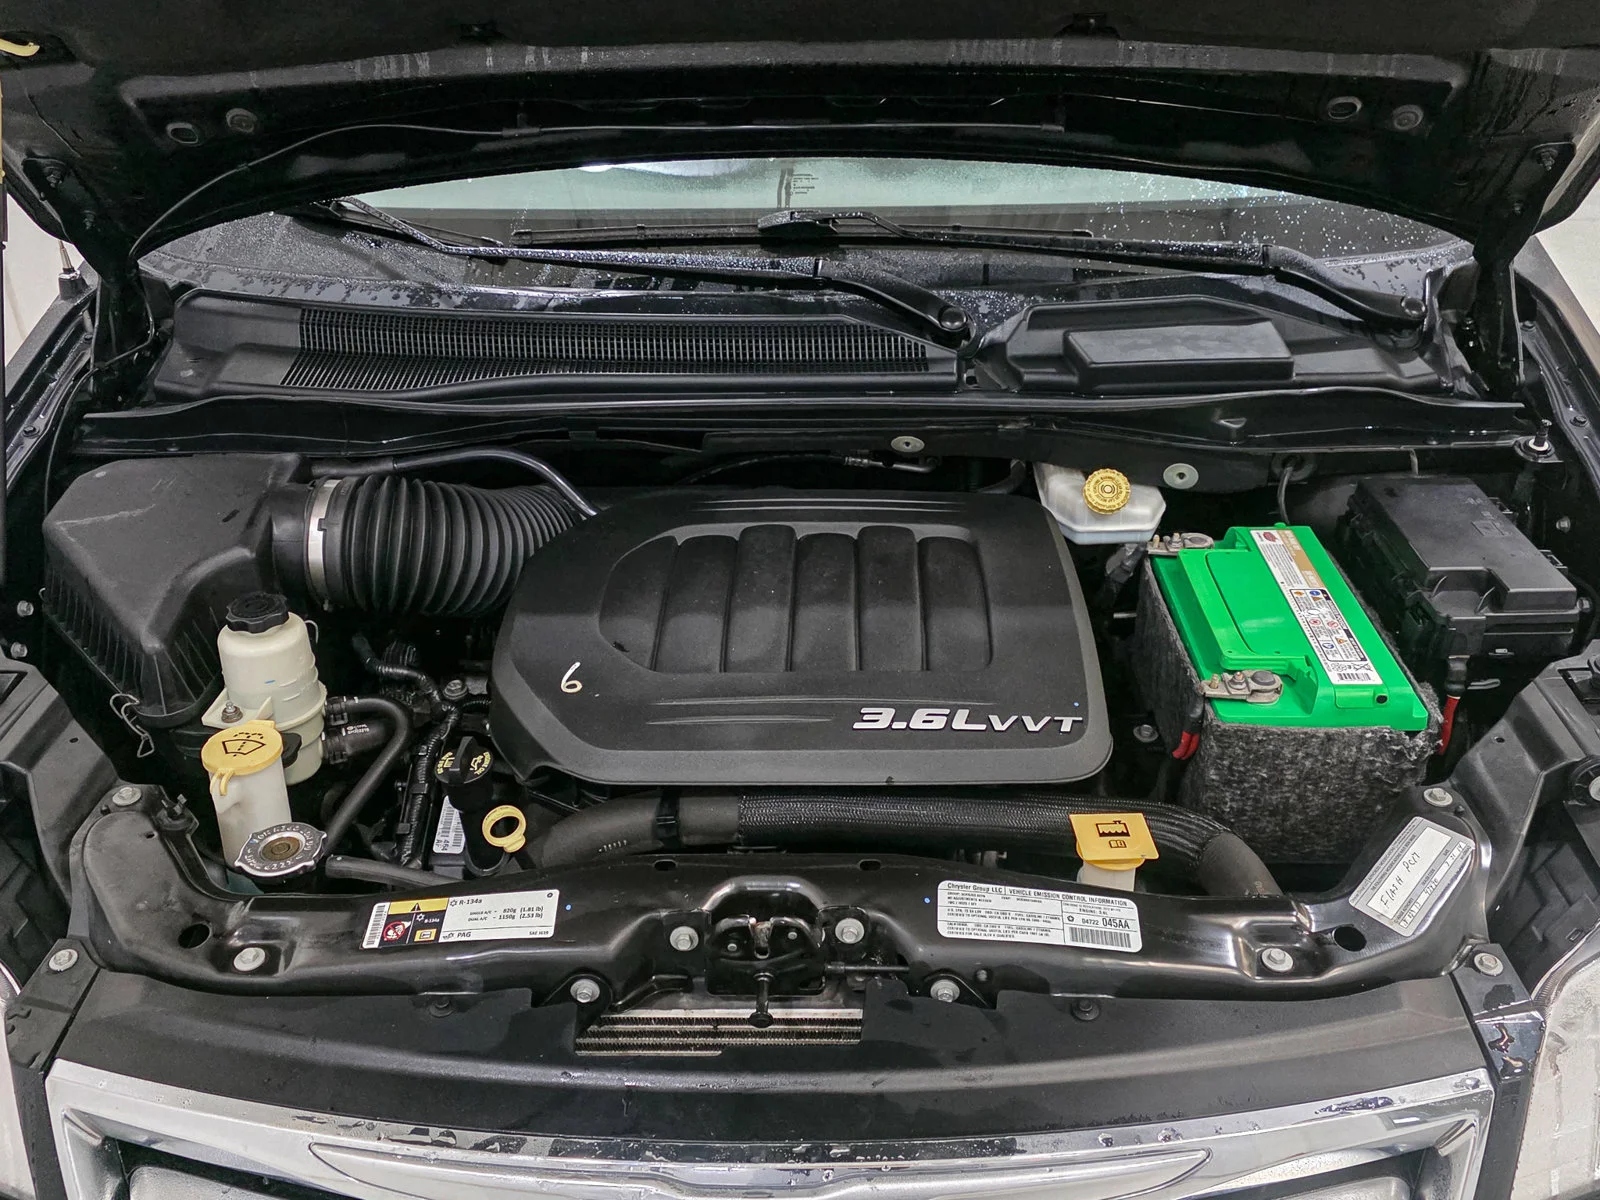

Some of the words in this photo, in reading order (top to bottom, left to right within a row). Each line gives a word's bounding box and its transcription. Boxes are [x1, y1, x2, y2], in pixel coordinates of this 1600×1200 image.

[560, 661, 583, 693] 6
[852, 707, 987, 731] 3.6L
[987, 714, 1084, 732] VVT
[947, 882, 971, 891] Chrysler
[972, 884, 990, 893] Group
[459, 898, 482, 906] R-134a
[1008, 888, 1031, 896] VEHICLE
[1033, 890, 1060, 899] EMISSION
[1062, 894, 1087, 902] CONTROL
[1088, 897, 1128, 906] INFORMATION
[1102, 917, 1130, 929] 045AA
